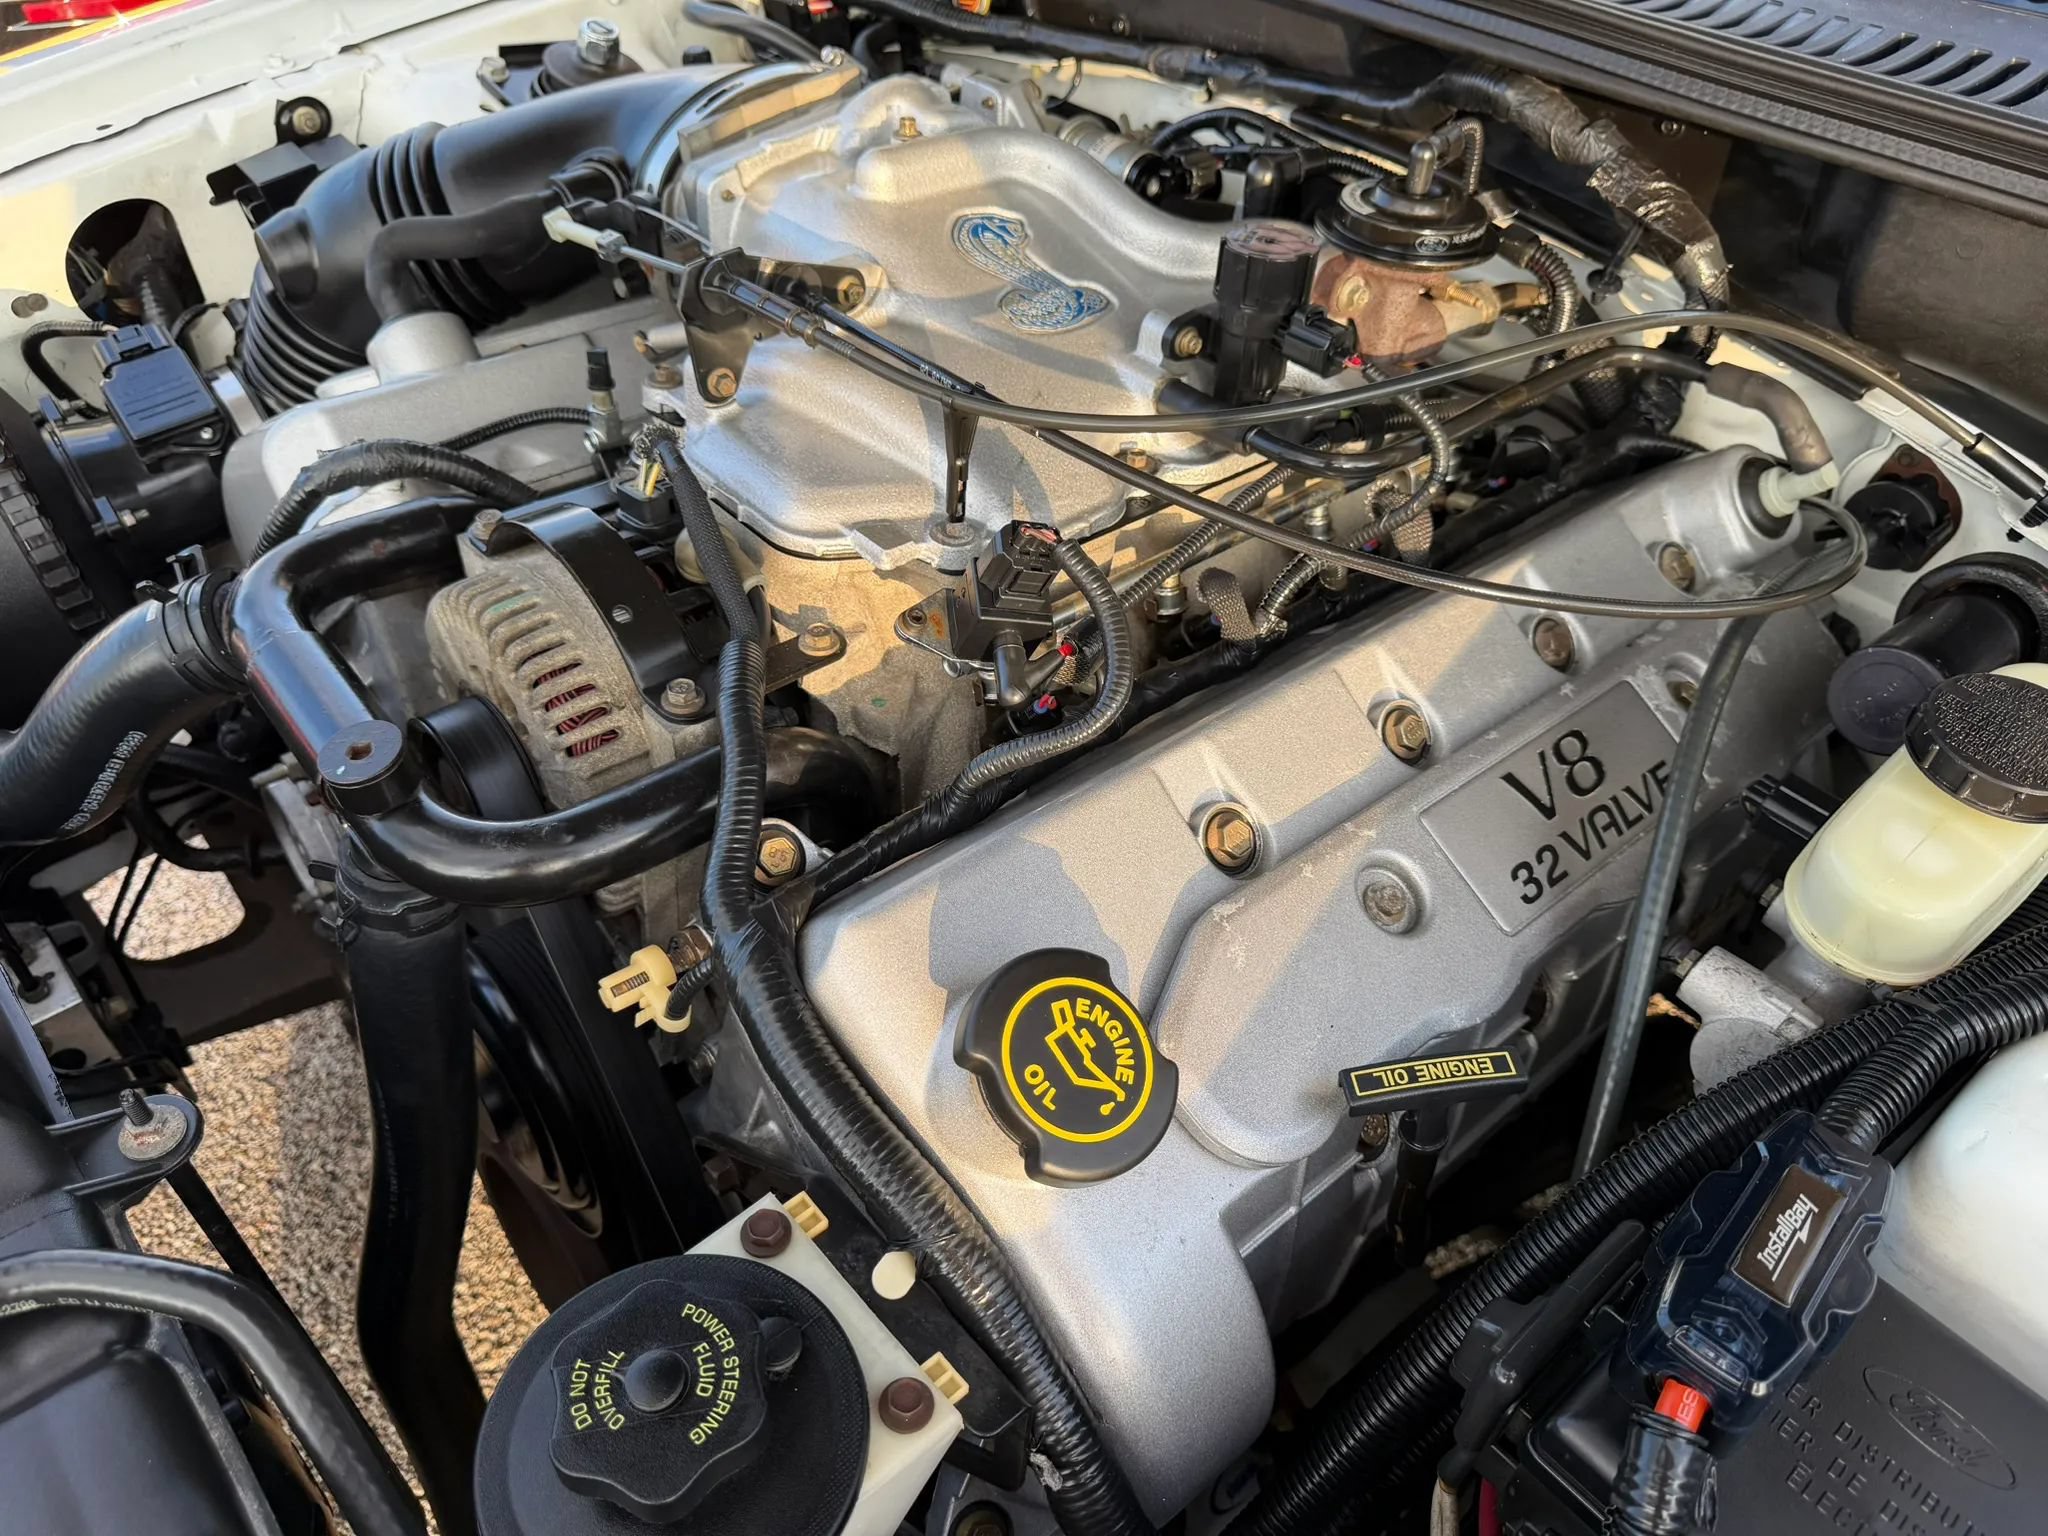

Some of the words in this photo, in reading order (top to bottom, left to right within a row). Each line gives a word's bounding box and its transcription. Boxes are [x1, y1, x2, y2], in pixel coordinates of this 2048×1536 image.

[1499, 728, 1606, 821] V8
[1510, 843, 1569, 905] 32
[1076, 997, 1135, 1085] ENGINE
[1024, 1064, 1056, 1111] OIL
[1373, 1068, 1409, 1087] OIL
[1414, 1057, 1495, 1082] ENGINE
[1757, 1193, 1819, 1271] InstallBay
[681, 1303, 735, 1352] POWER
[569, 1358, 591, 1396] NOT
[593, 1350, 626, 1430] OVERFILL
[692, 1342, 716, 1397] FLUID
[570, 1402, 593, 1430] DO
[689, 1356, 740, 1445] STEERING
[1827, 1456, 1868, 1496] DE
